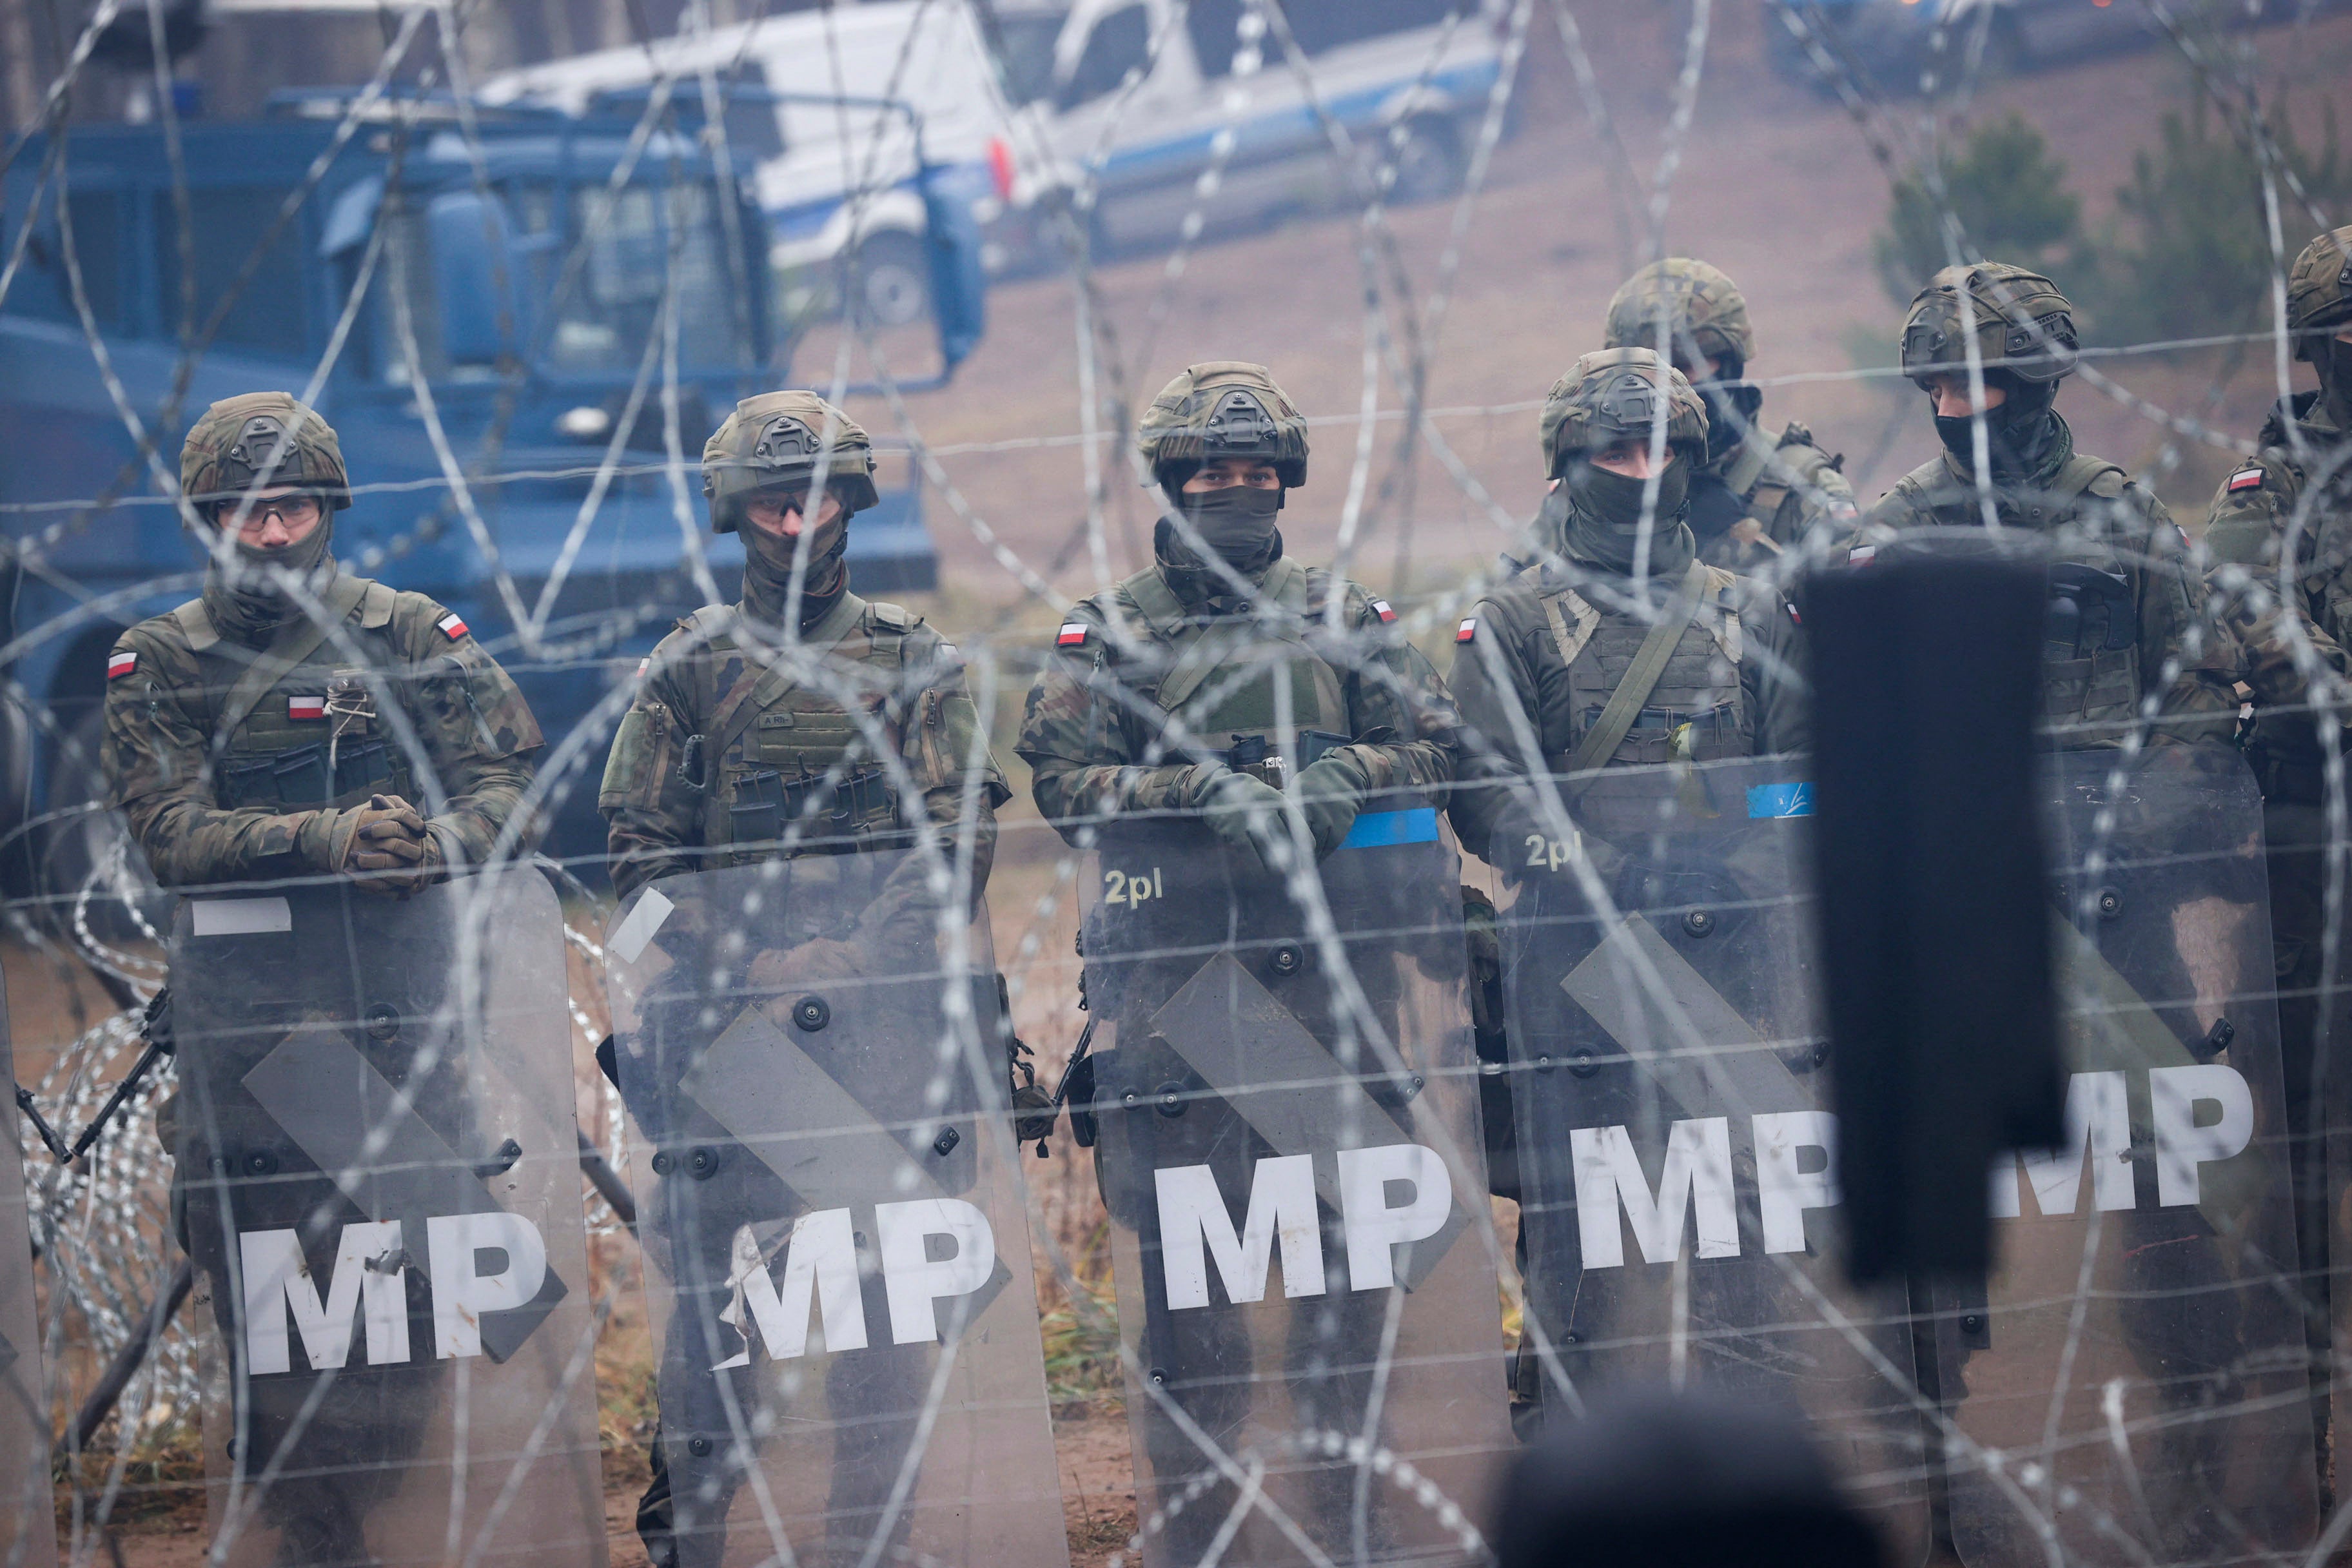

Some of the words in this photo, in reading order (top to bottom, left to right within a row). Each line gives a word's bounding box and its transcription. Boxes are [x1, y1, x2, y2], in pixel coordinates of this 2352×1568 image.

[1105, 867, 1162, 910] 2pl
[1525, 830, 1582, 872] 2pl
[1570, 1110, 1845, 1270] MP
[1987, 1064, 2254, 1219] MP
[240, 1212, 547, 1375] MP
[710, 1199, 995, 1371] MP
[1154, 1143, 1453, 1311] MP
